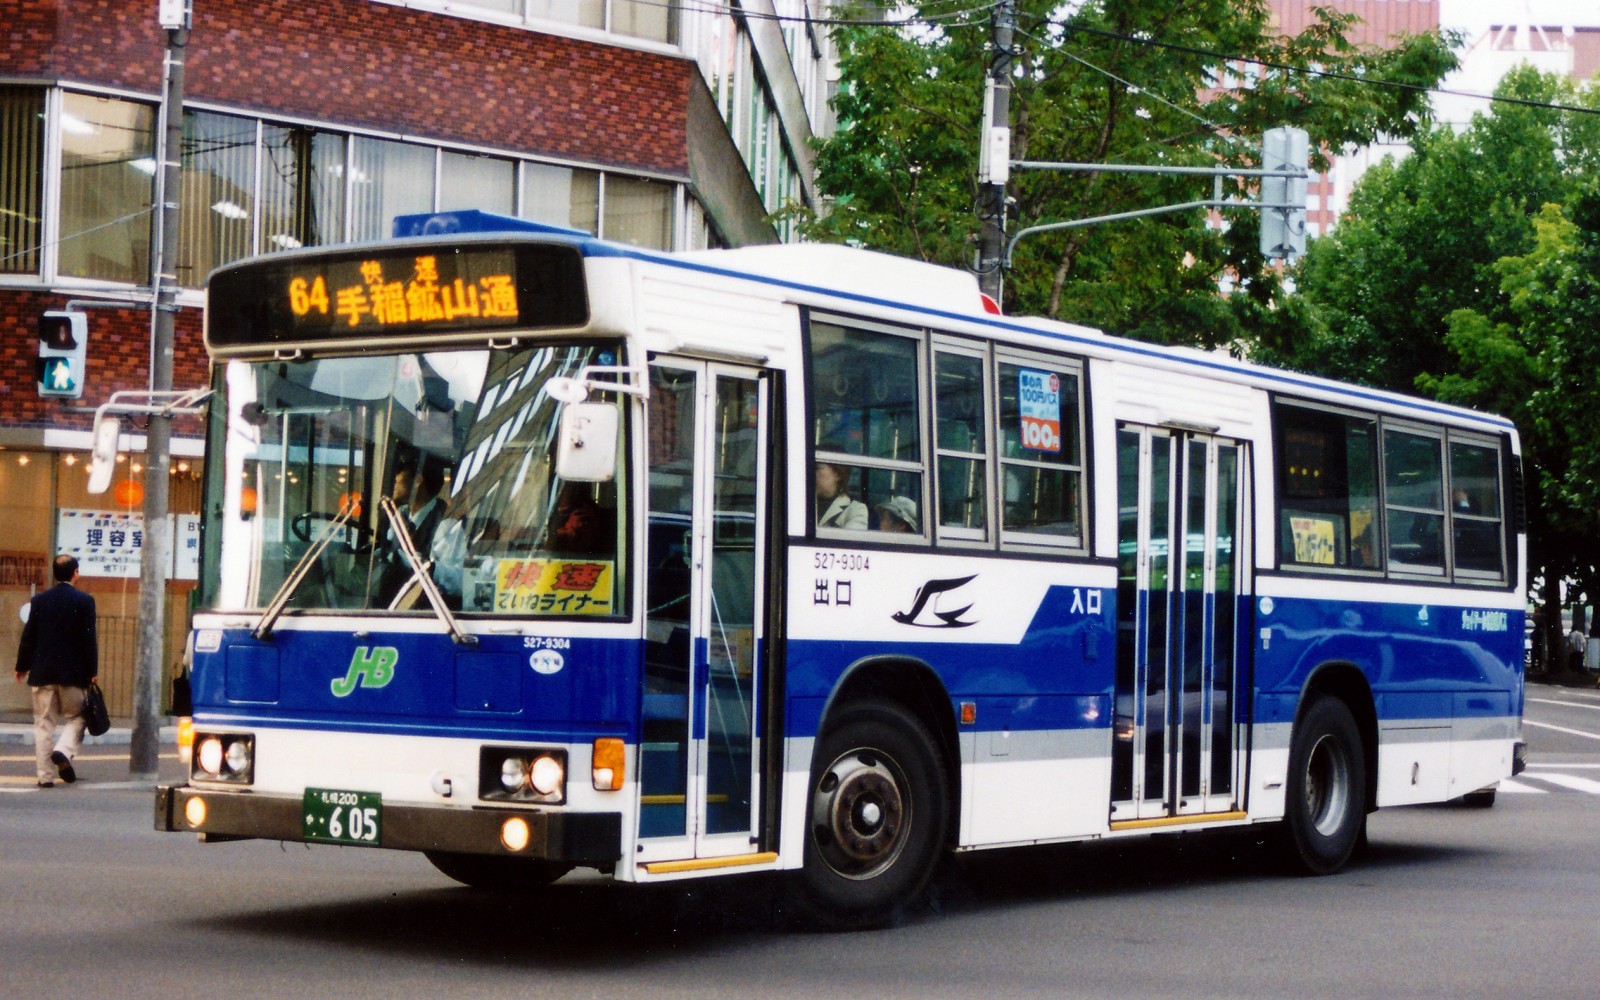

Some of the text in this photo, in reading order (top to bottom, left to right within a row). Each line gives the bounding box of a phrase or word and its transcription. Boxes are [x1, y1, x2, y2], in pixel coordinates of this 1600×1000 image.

[360, 255, 439, 284] 快速
[289, 275, 329, 316] 64
[814, 552, 870, 570] 527-9304
[504, 561, 606, 591] 快速
[498, 593, 609, 611] ていねライナー
[814, 578, 851, 606] 出口
[1070, 588, 1101, 615] 入口
[523, 637, 570, 649] 527-9304
